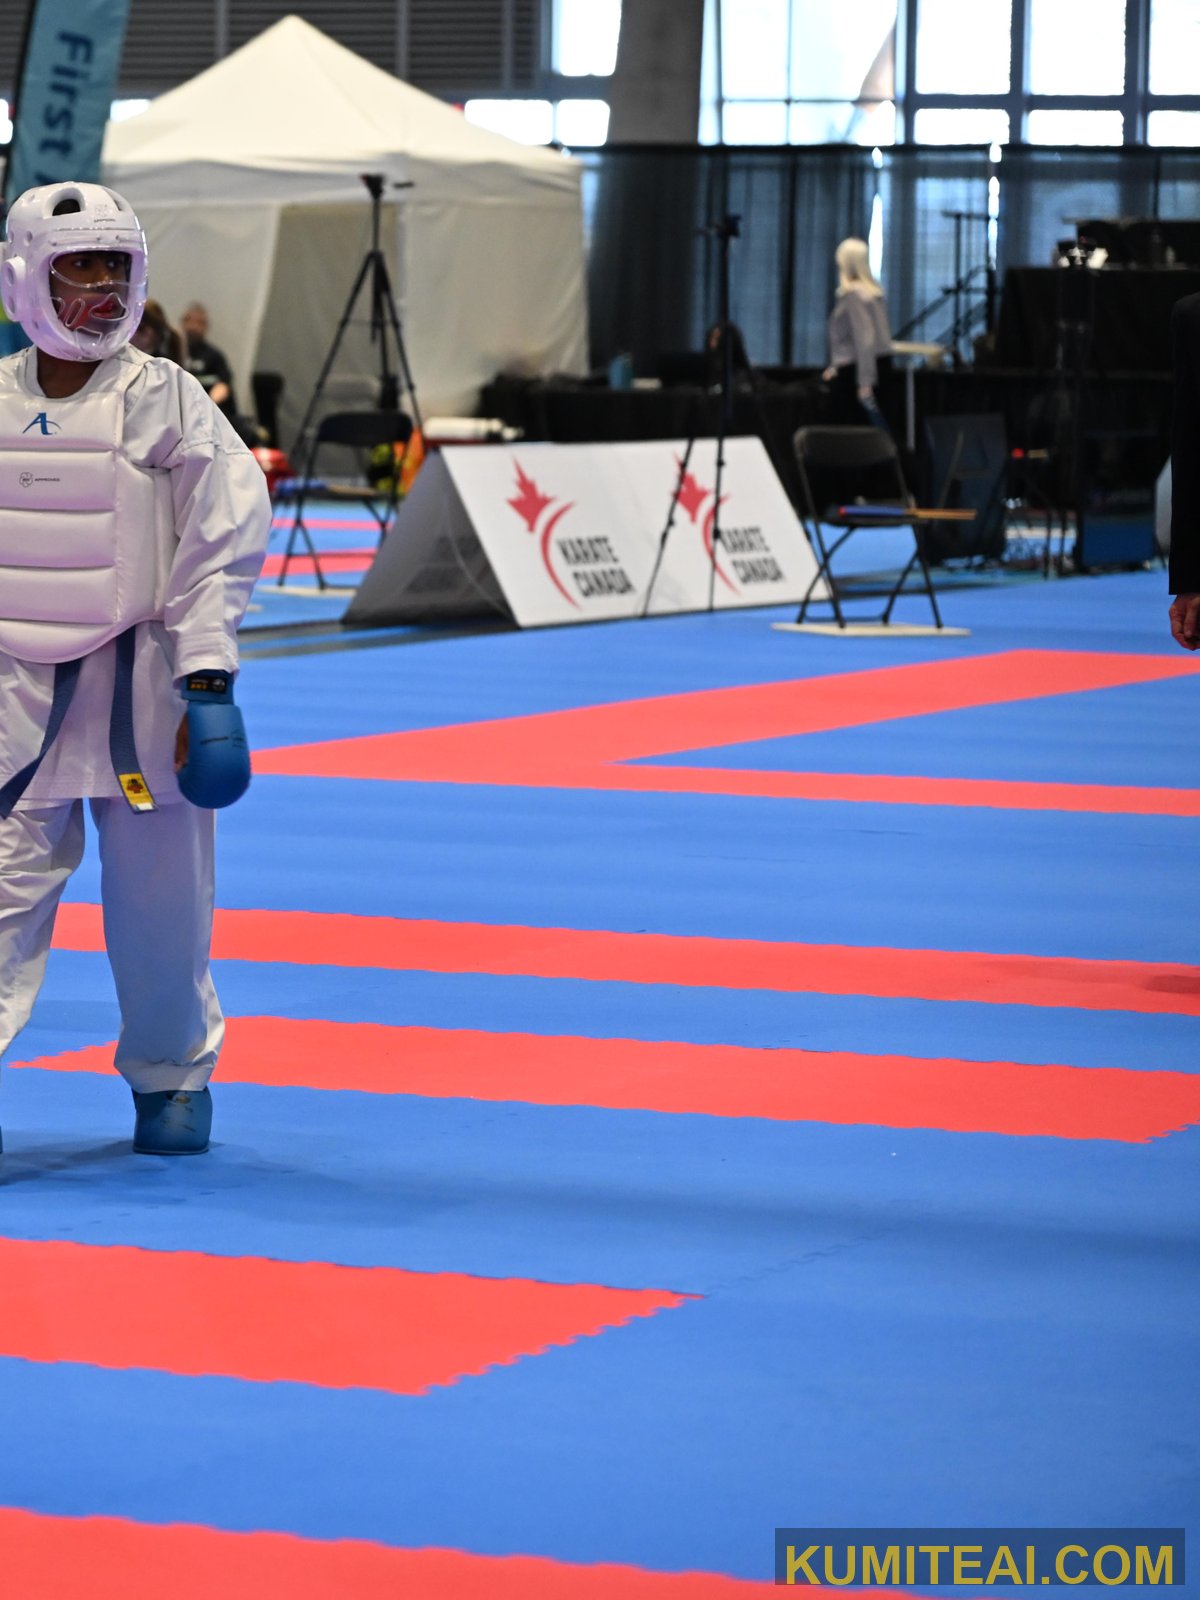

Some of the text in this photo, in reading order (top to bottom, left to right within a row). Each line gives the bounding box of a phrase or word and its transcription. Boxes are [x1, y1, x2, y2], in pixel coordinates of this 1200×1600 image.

[38, 29, 94, 158] First
[556, 536, 619, 565] KARATE
[572, 567, 636, 597] CANADA
[731, 557, 784, 585] CANADA
